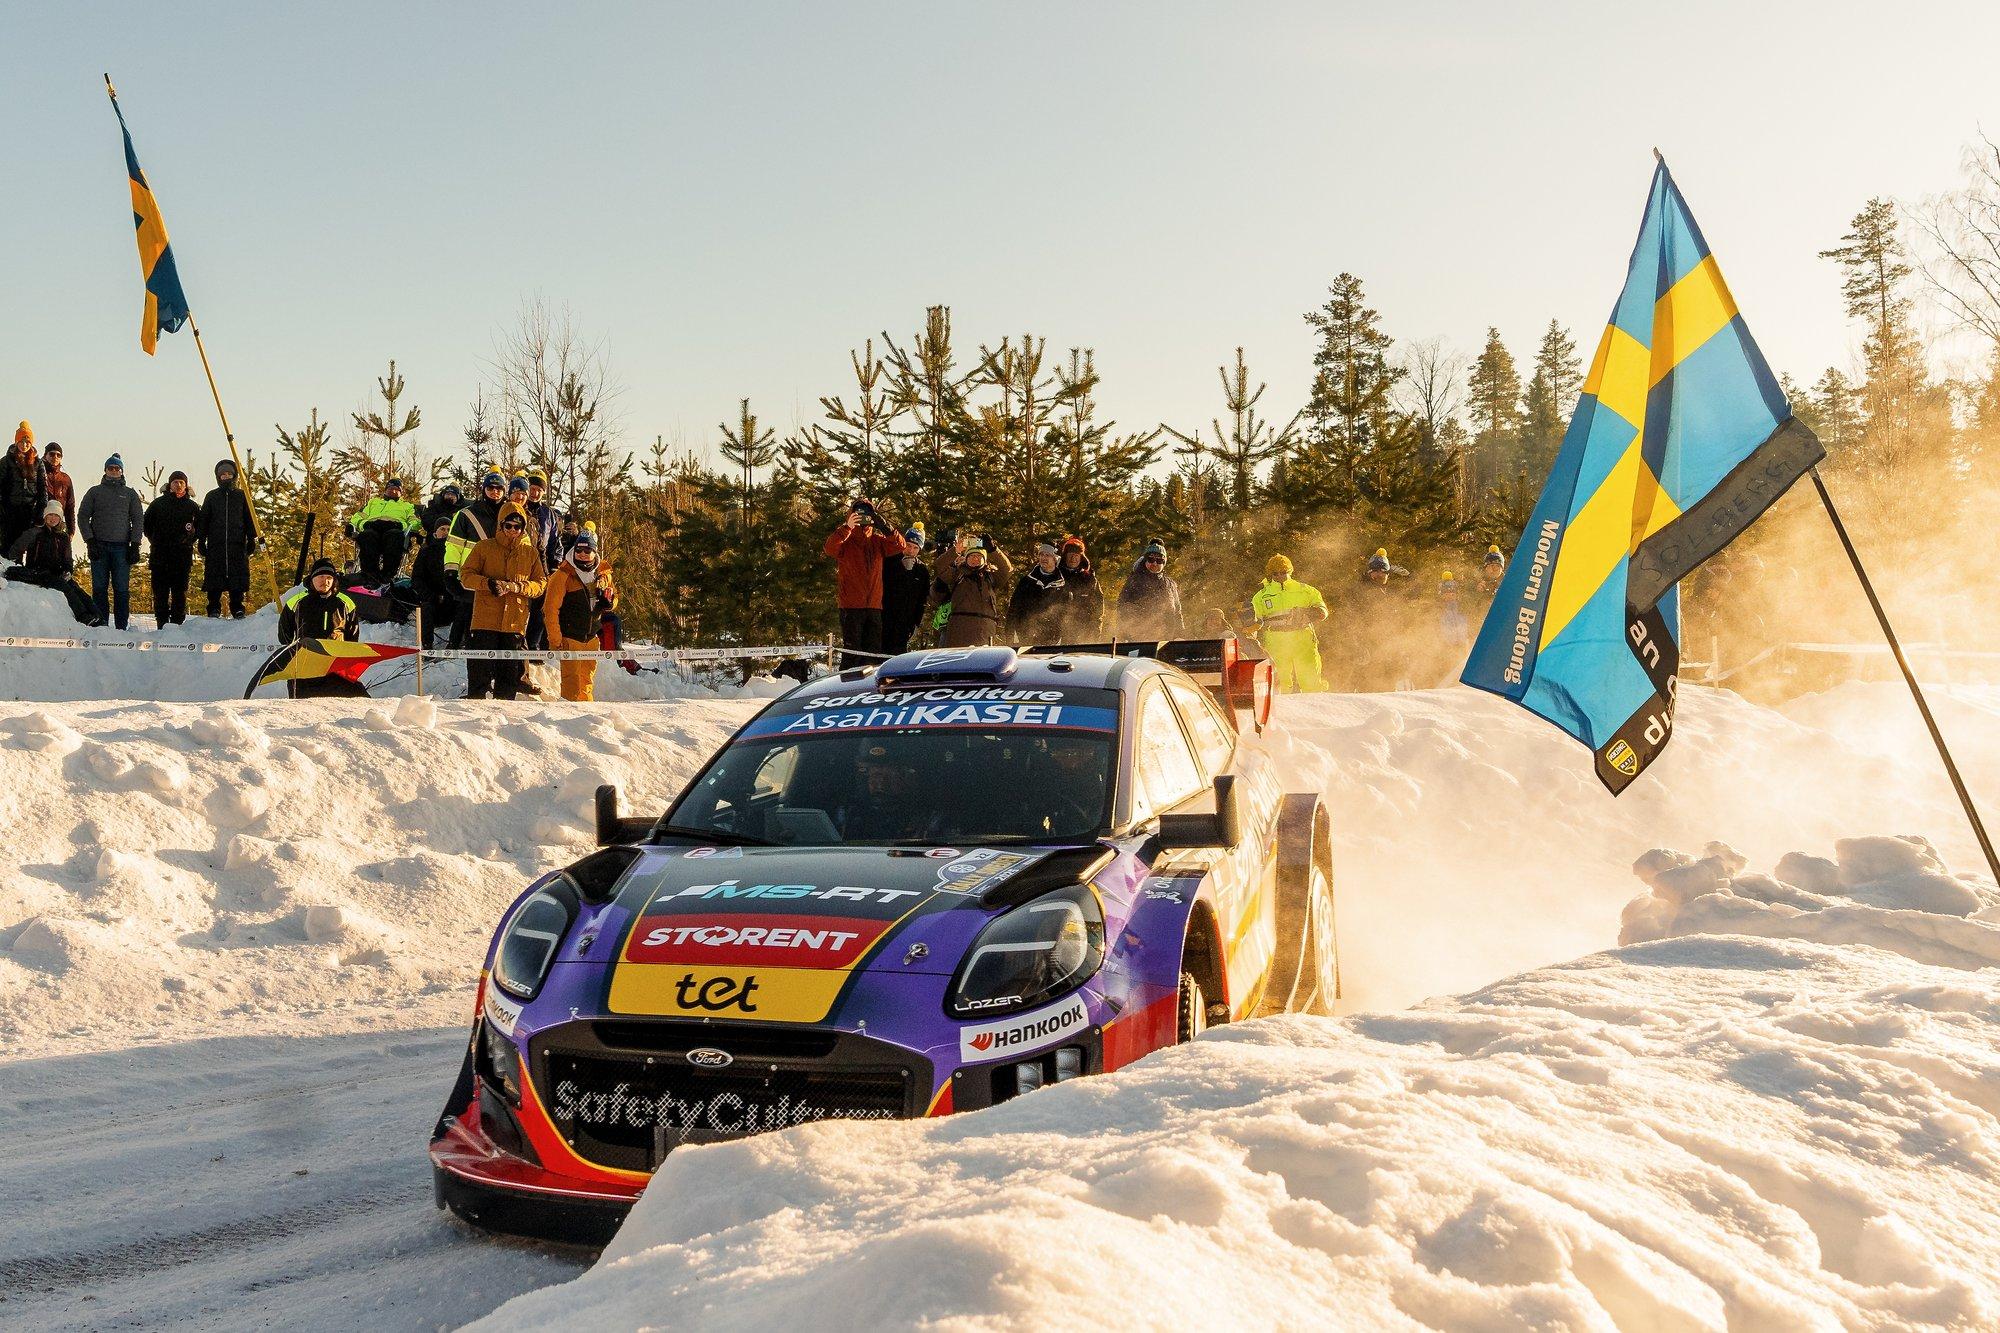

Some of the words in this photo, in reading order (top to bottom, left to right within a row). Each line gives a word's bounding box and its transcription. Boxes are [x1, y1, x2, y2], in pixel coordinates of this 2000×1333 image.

[1521, 519, 1560, 601] Modern
[1503, 606, 1538, 685] Betong
[803, 687, 1064, 710] SafetyCulture
[700, 884, 922, 903] MS-RT
[642, 925, 859, 951] STORENT
[675, 973, 760, 1012] tet
[953, 994, 1023, 1011] LAZER
[695, 1051, 723, 1065] Ford
